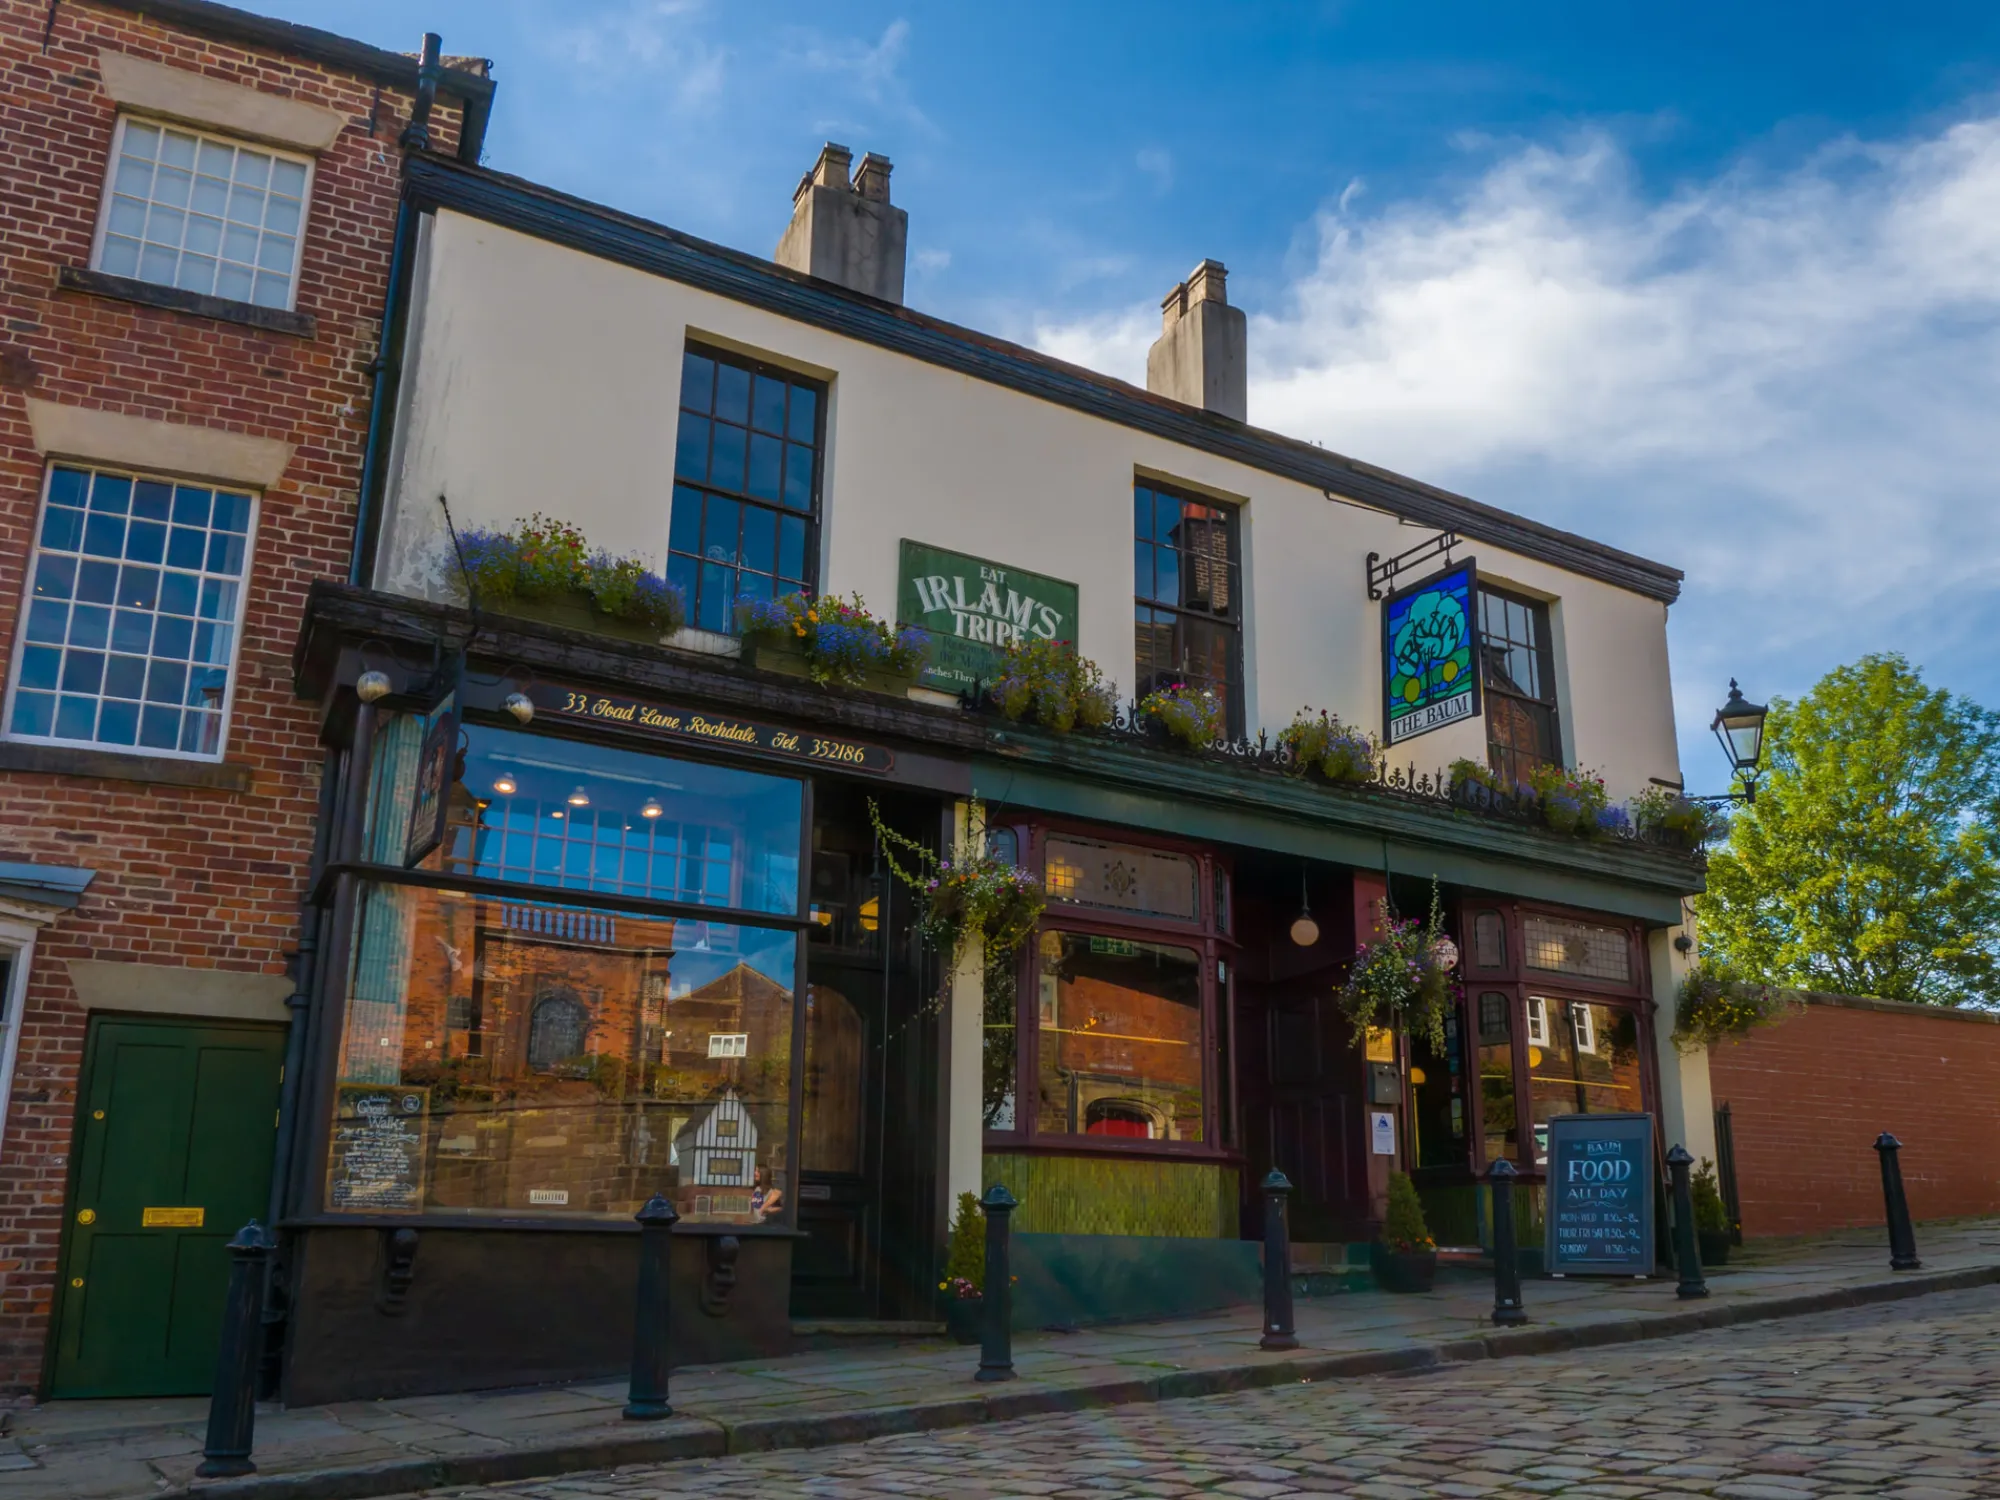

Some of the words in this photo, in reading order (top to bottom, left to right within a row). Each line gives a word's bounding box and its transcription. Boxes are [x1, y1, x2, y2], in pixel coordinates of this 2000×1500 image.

[980, 566, 1007, 584] EAT
[912, 575, 1063, 640] IRLAM'S
[1392, 713, 1423, 737] THE
[1427, 694, 1469, 725] BAUM
[591, 698, 637, 721] Toad
[686, 716, 758, 744] Rochdale.
[771, 731, 800, 752] Tel.
[809, 738, 865, 763] 352186
[1568, 1160, 1631, 1182] FOOD
[1600, 1188, 1627, 1199] DAY
[1559, 1244, 1588, 1255] SUNDAY
